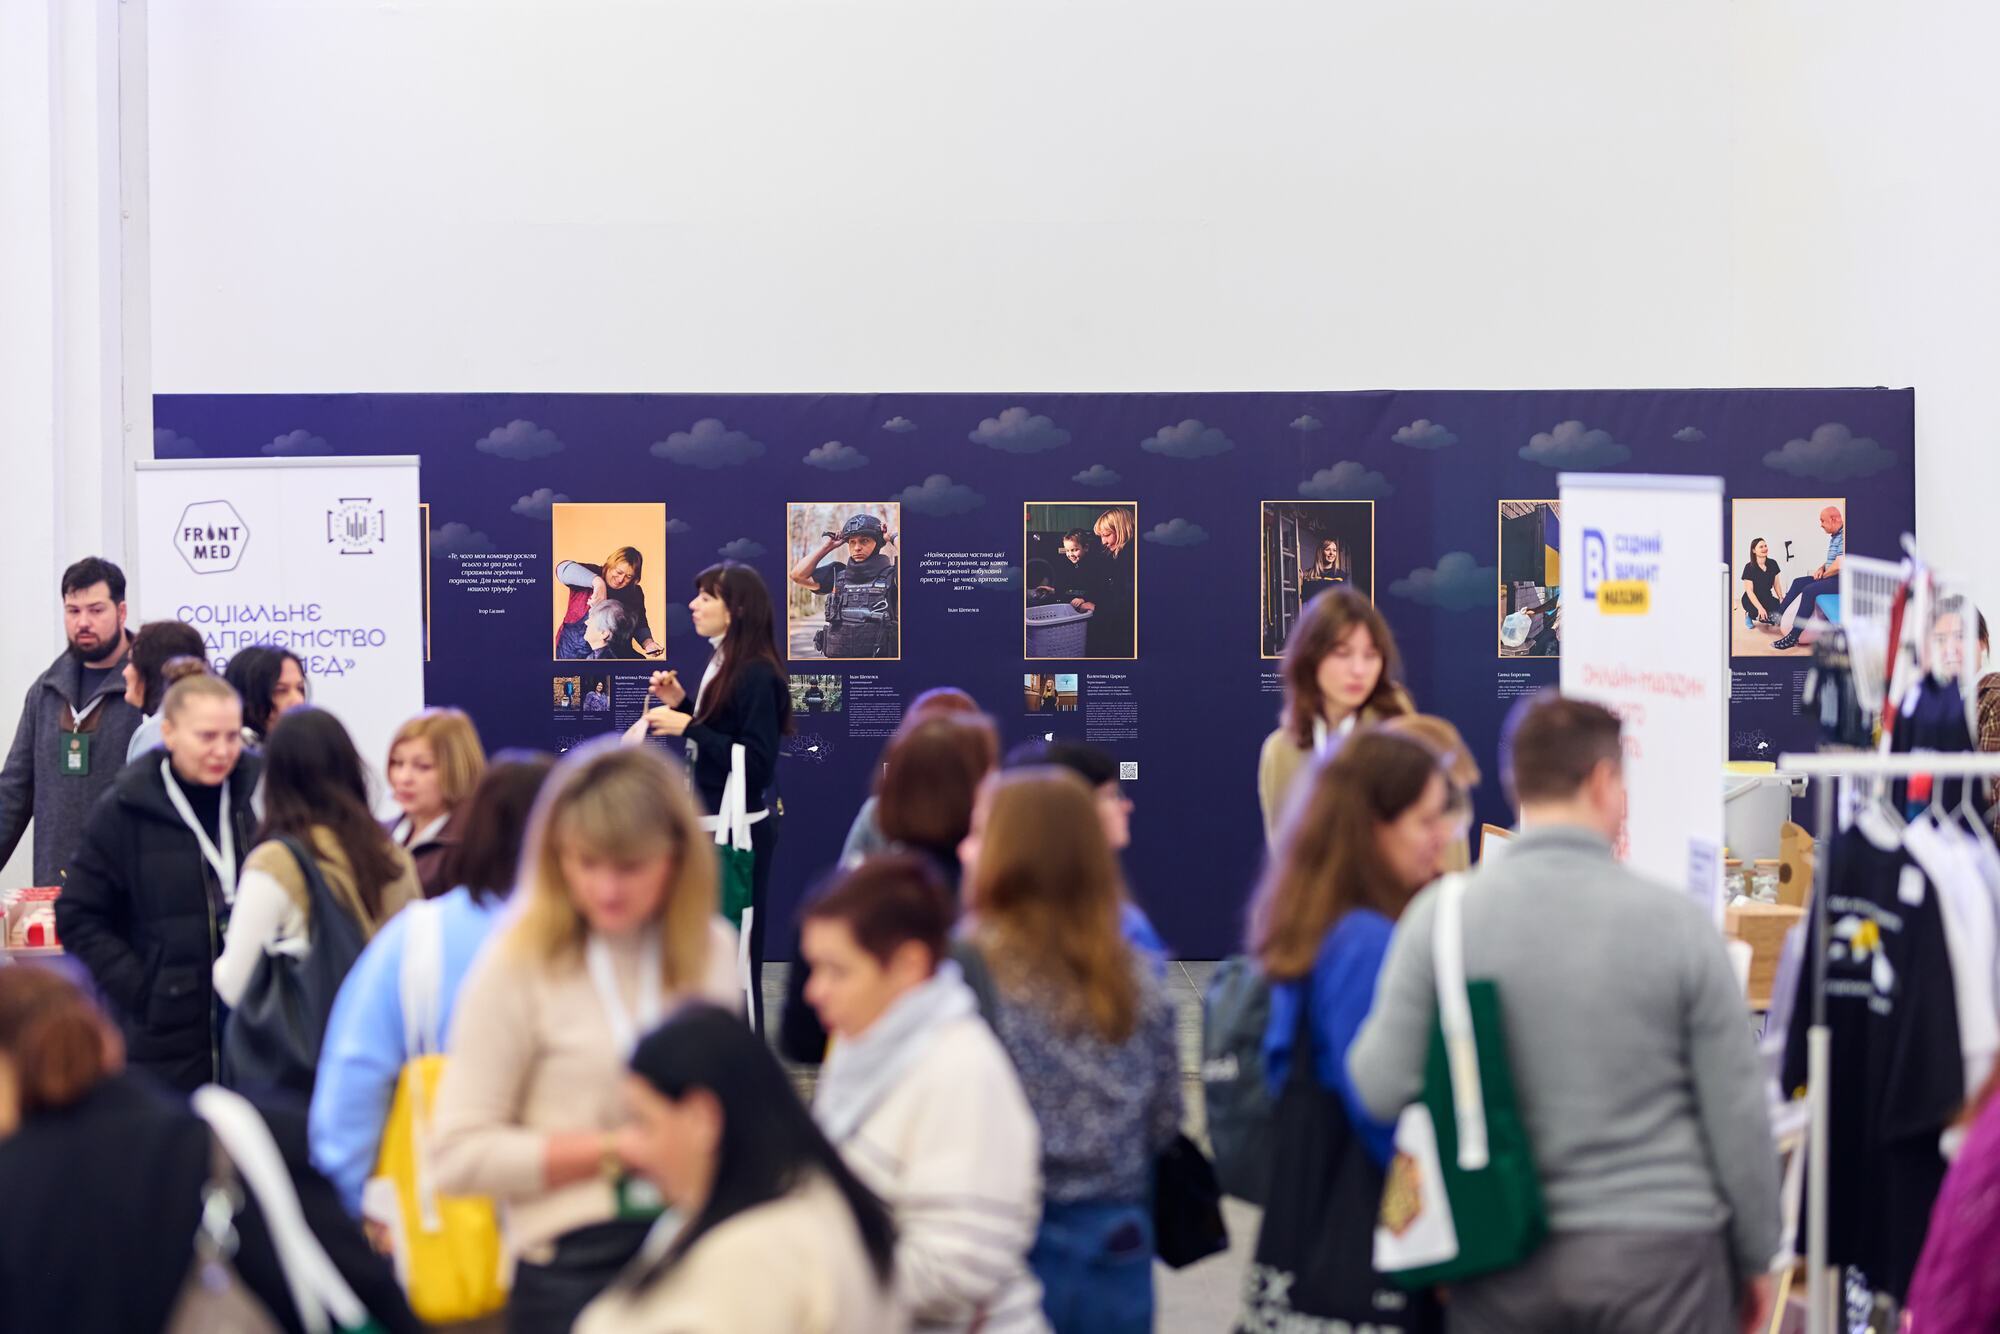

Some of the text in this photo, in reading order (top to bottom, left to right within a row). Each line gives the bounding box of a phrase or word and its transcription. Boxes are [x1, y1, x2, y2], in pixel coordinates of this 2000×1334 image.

[193, 544, 231, 560] MED
[516, 578, 536, 586] історія
[920, 576, 946, 584] пристрій
[490, 585, 517, 594] тріумфу»
[176, 603, 323, 627] СОЦІАЛЬНЕ
[204, 628, 386, 652] ДПРИЄМСТВО
